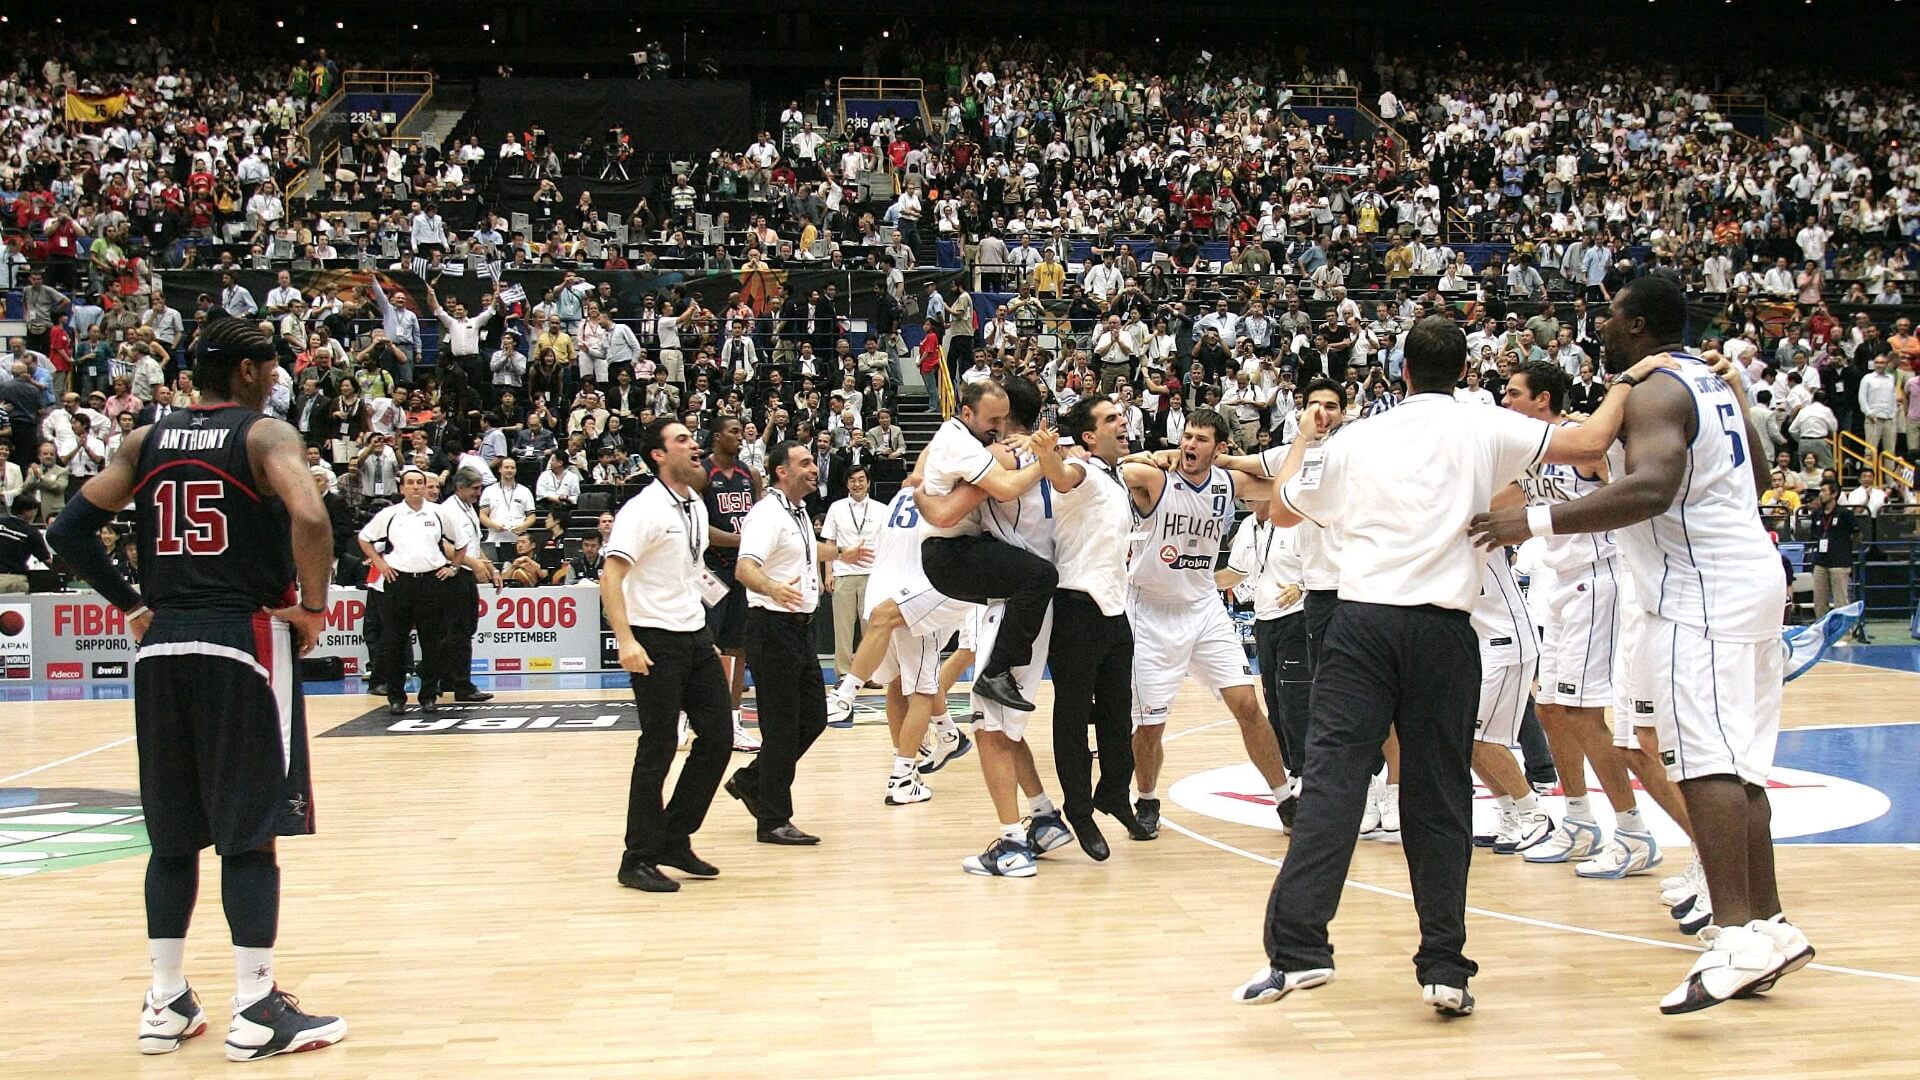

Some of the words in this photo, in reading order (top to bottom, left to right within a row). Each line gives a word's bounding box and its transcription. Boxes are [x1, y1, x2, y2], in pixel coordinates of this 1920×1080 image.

[159, 428, 231, 451] ANTHONY
[1716, 403, 1746, 469] 5
[716, 491, 754, 514] USA
[887, 494, 920, 529] 13
[1212, 495, 1226, 518] 9
[154, 480, 229, 556] 15
[1162, 511, 1223, 542] HELLAS
[54, 604, 126, 636] FIBA
[496, 596, 577, 629] 2006
[0, 642, 29, 650] APAN
[75, 638, 131, 652] SAPPORO,
[493, 631, 557, 643] SEPTEMBER
[6, 656, 30, 664] WORLD
[386, 714, 621, 732] FIBA
